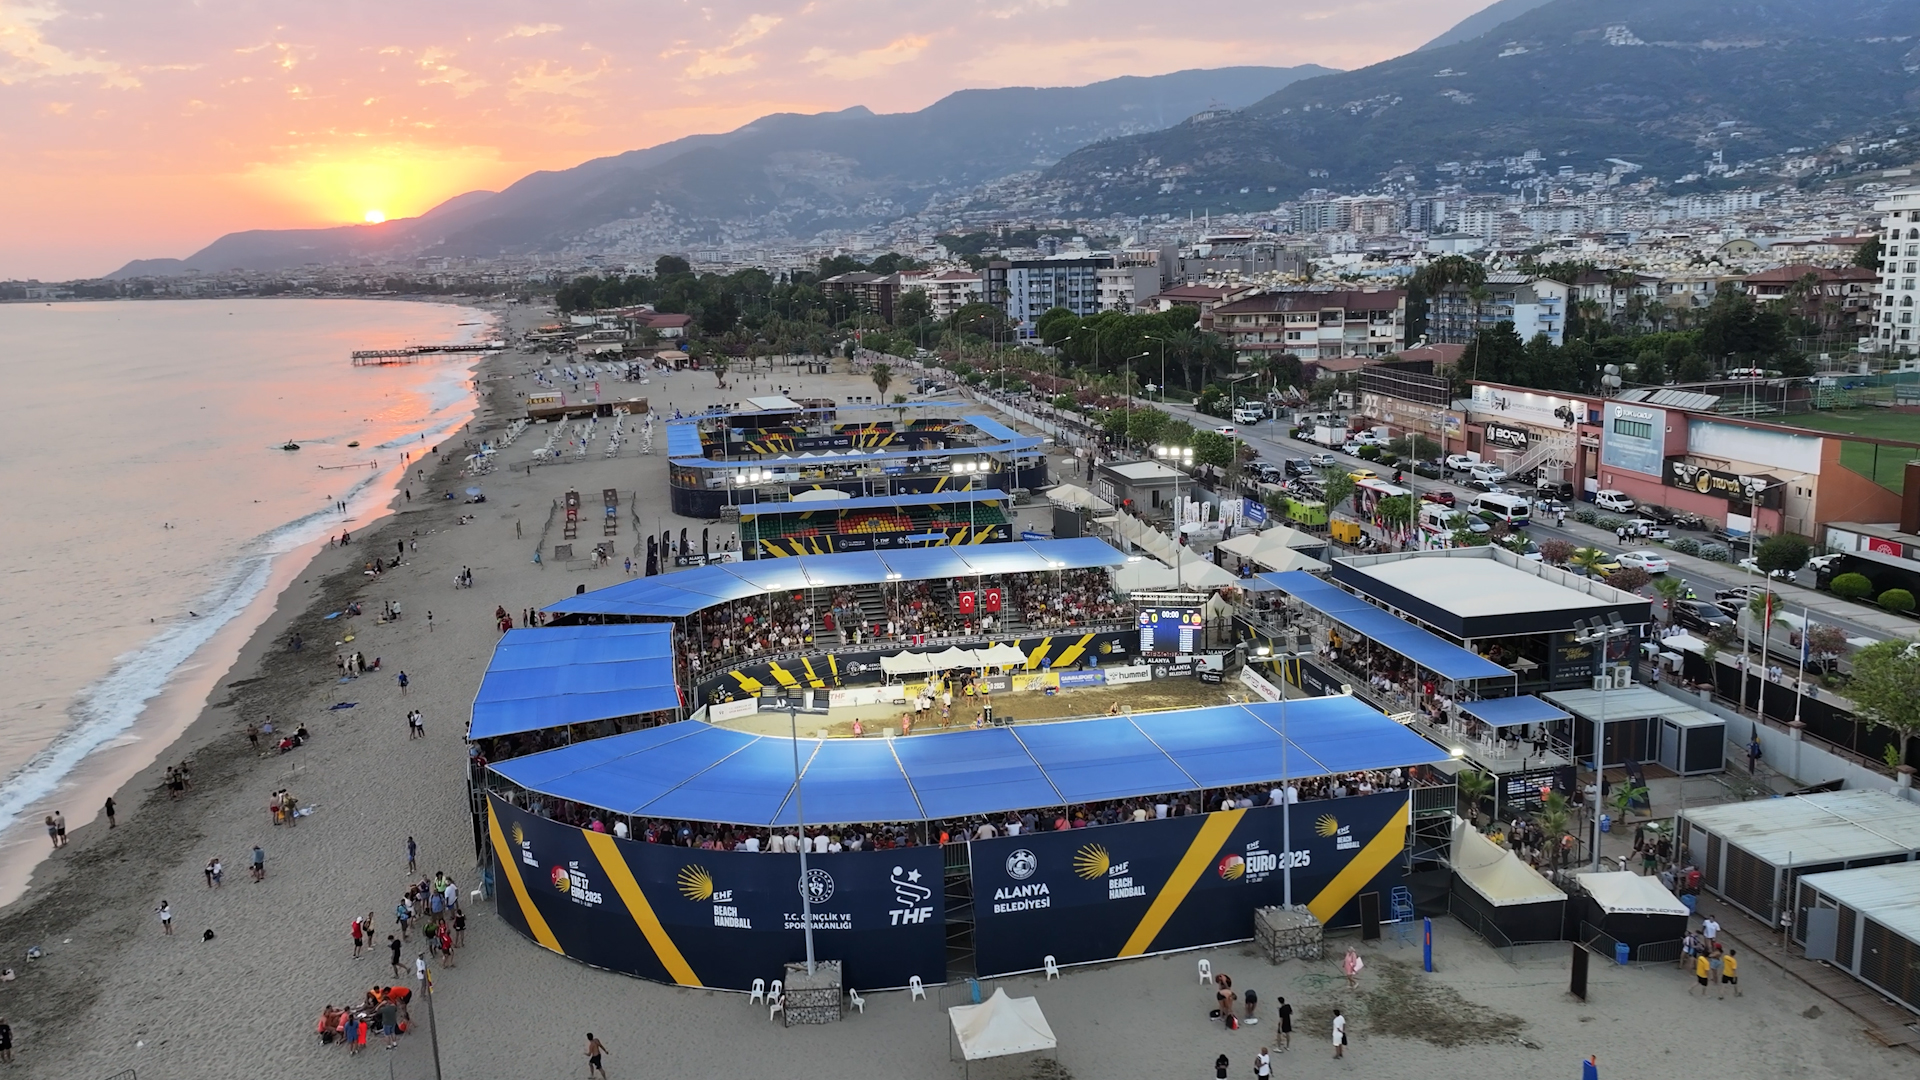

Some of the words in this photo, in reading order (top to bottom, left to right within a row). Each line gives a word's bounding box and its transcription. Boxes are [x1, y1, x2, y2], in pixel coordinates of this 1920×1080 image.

[1364, 394, 1379, 418] 23
[1151, 613, 1158, 623] 0
[1182, 614, 1189, 624] 0
[1119, 669, 1149, 679] hummel
[1109, 861, 1129, 875] EHF
[1246, 854, 1276, 873] EURO
[1278, 850, 1310, 870] 2025
[581, 878, 589, 890] 17
[1109, 877, 1133, 889] BEACH
[571, 885, 584, 900] EURO
[585, 891, 602, 904] 2025
[713, 890, 733, 900] EHF
[994, 883, 1050, 900] ALANYA
[1109, 886, 1146, 899] HANDBALL
[713, 905, 738, 917] BEACH
[994, 896, 1050, 913] BELEDİYESİ
[714, 916, 752, 929] HANDBALL
[889, 906, 934, 926] THF
